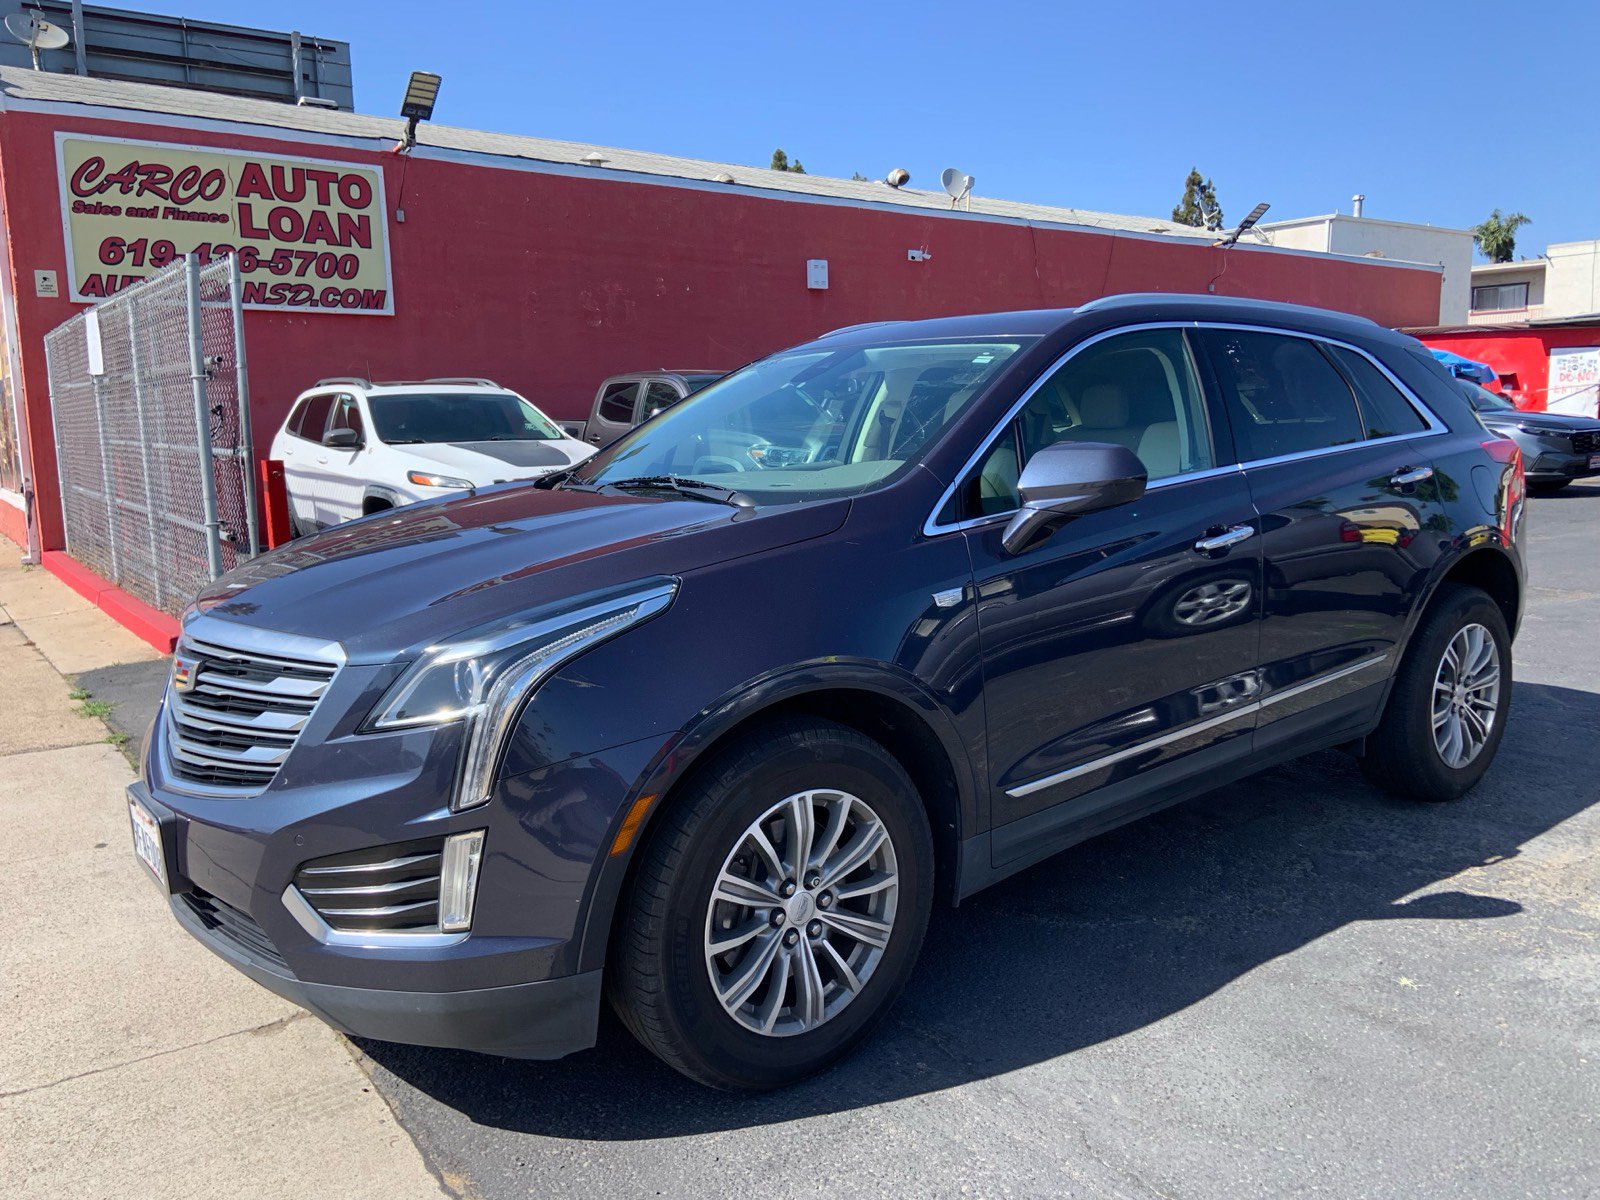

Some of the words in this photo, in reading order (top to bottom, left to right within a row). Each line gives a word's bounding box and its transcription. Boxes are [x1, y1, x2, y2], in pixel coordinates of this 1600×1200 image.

[71, 156, 226, 205] CARCO
[235, 162, 373, 210] AUTO
[71, 199, 122, 216] Sales
[125, 205, 159, 219] and
[161, 206, 230, 224] Finance
[237, 202, 373, 249] LOAN
[78, 273, 387, 310] AUNSD.COM
